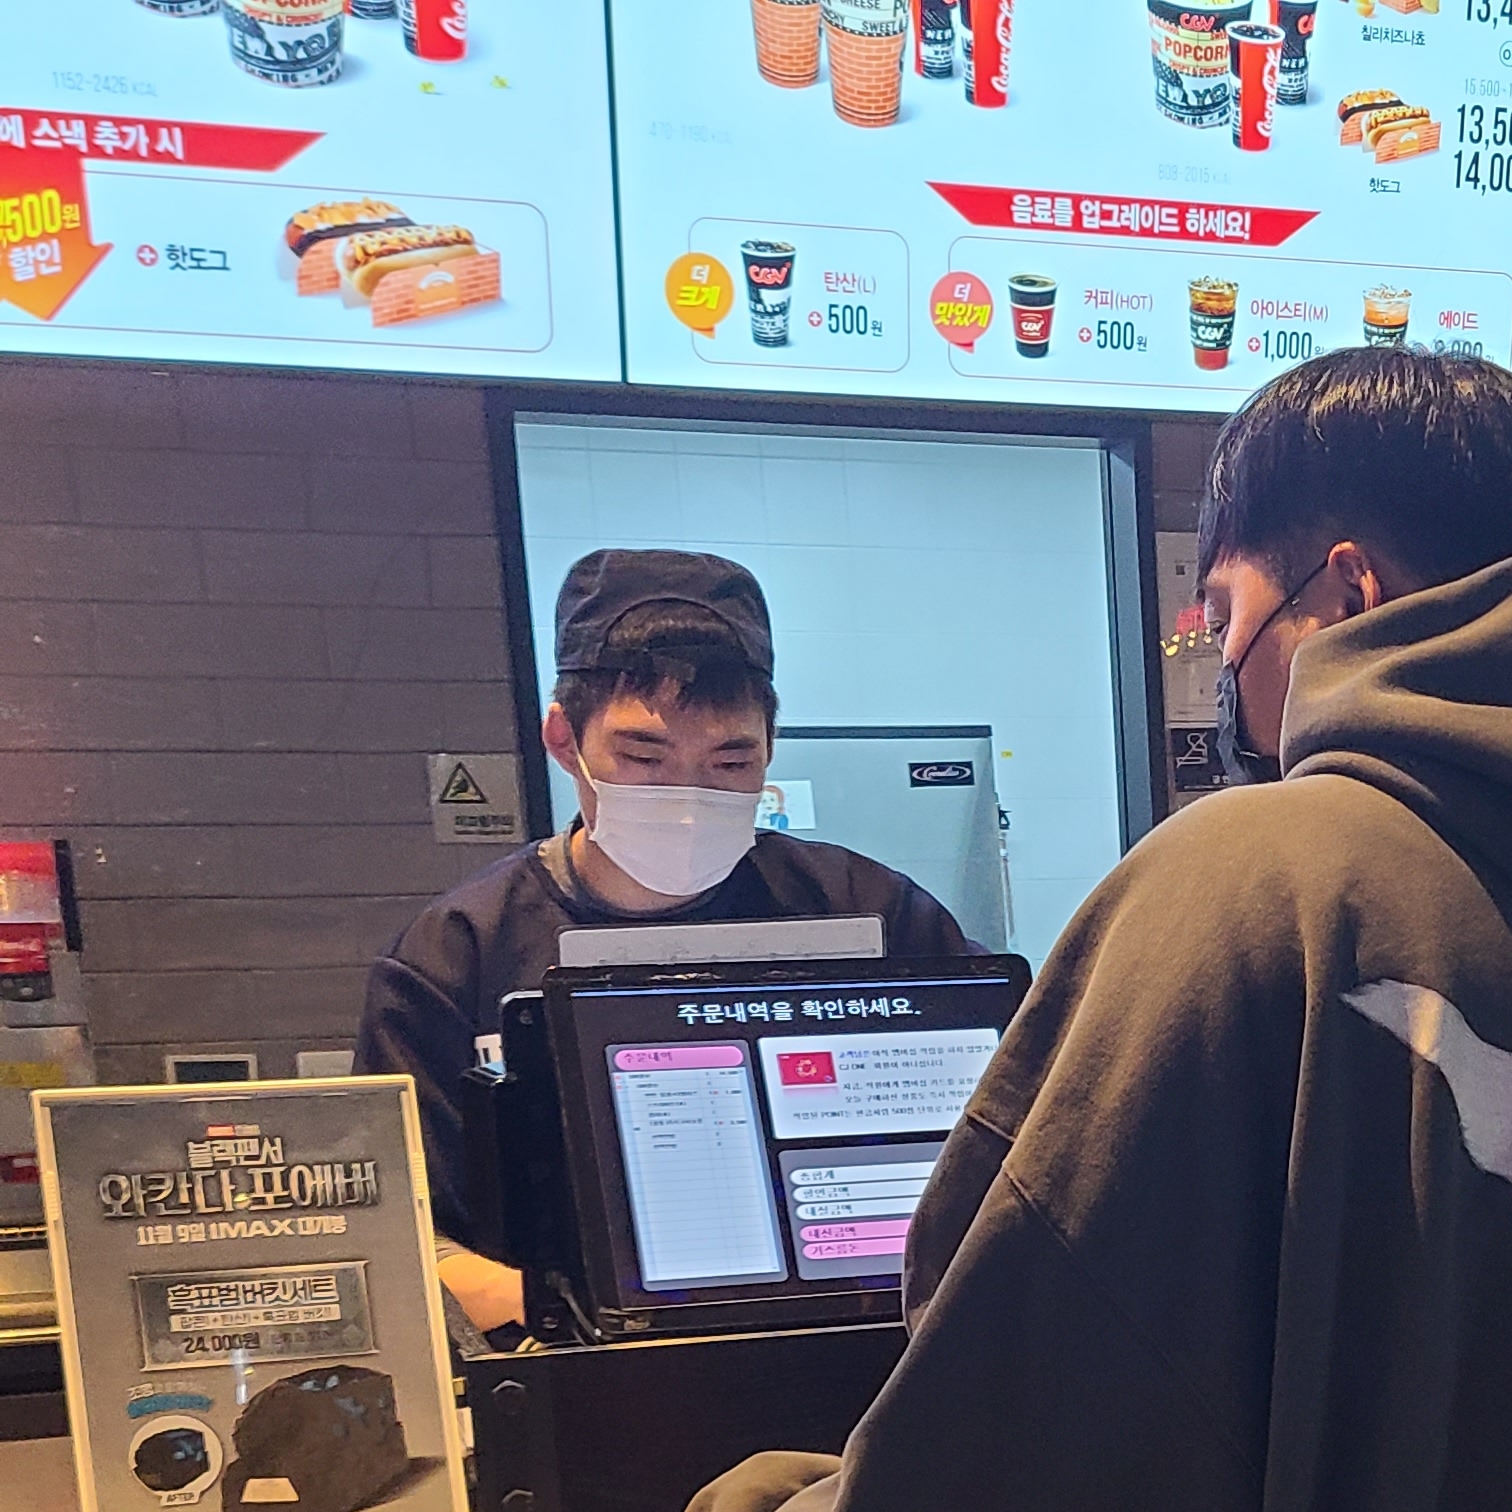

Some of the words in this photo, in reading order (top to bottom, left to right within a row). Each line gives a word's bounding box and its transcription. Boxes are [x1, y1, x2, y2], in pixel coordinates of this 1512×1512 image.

[1180, 13, 1215, 32] CGV
[1361, 24, 1426, 46] 칠리치즈나쵸
[31, 117, 88, 153] 스낵
[93, 120, 150, 158] 추가
[154, 126, 185, 161] 시
[1369, 176, 1401, 194] 핫도그
[1010, 194, 1074, 229] 음료를
[1080, 199, 1180, 234] 업그레이드
[1185, 208, 1251, 241] 하세요!
[8, 238, 62, 283] 할인
[165, 243, 231, 272] 핫도그
[690, 264, 710, 284] 더
[749, 264, 788, 286] CGV
[823, 270, 877, 296] 탄산(L)
[675, 284, 721, 311] 크게
[952, 281, 971, 302] 더
[1083, 288, 1154, 313] 커피(HOT)
[827, 303, 884, 338] 500원
[933, 301, 992, 329] 맛있게
[1250, 298, 1329, 324] 아이스티(M)
[1438, 310, 1480, 331] 에이드
[1096, 320, 1148, 353] 500원
[676, 1000, 794, 1025] 주문내역을
[800, 996, 923, 1021] 확인하세요.
[99, 1167, 238, 1218] 와칸다
[247, 1160, 379, 1212] 포에버
